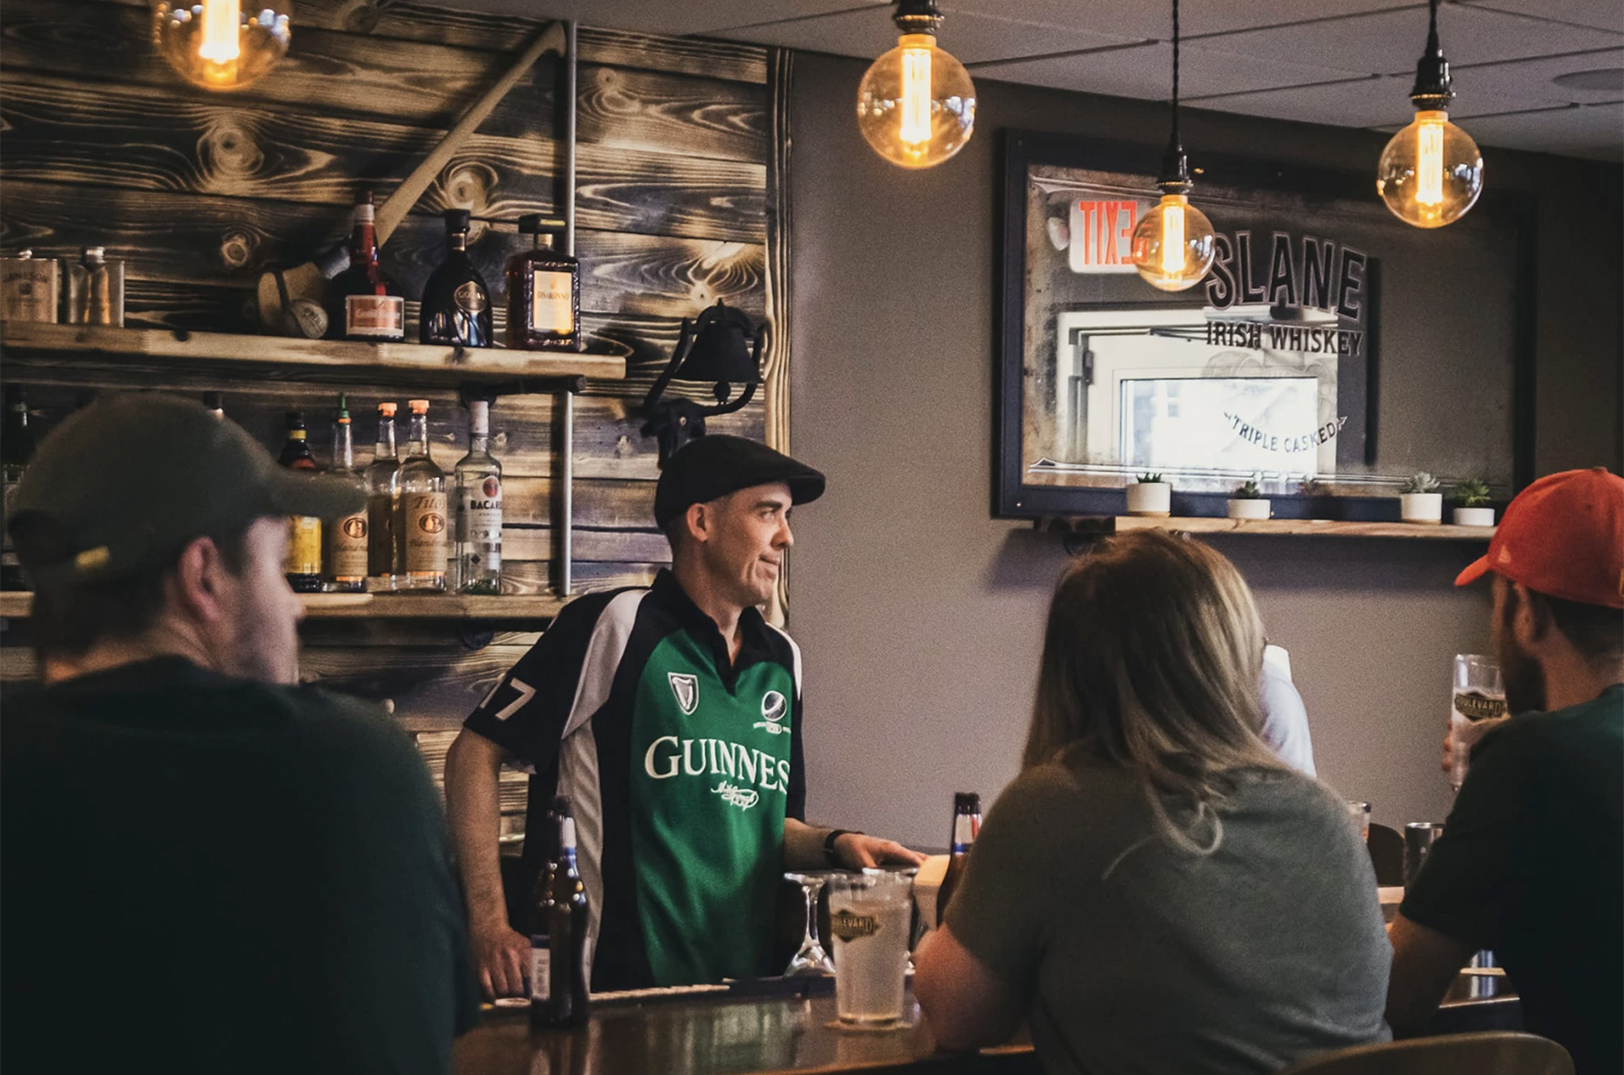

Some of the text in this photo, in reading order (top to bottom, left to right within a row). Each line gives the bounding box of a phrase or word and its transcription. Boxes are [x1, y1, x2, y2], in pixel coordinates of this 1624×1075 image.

[1205, 230, 1367, 321] SLANE
[1206, 320, 1364, 355] IRISH WHISKEY
[1233, 415, 1336, 453] TRIPLE CASKED
